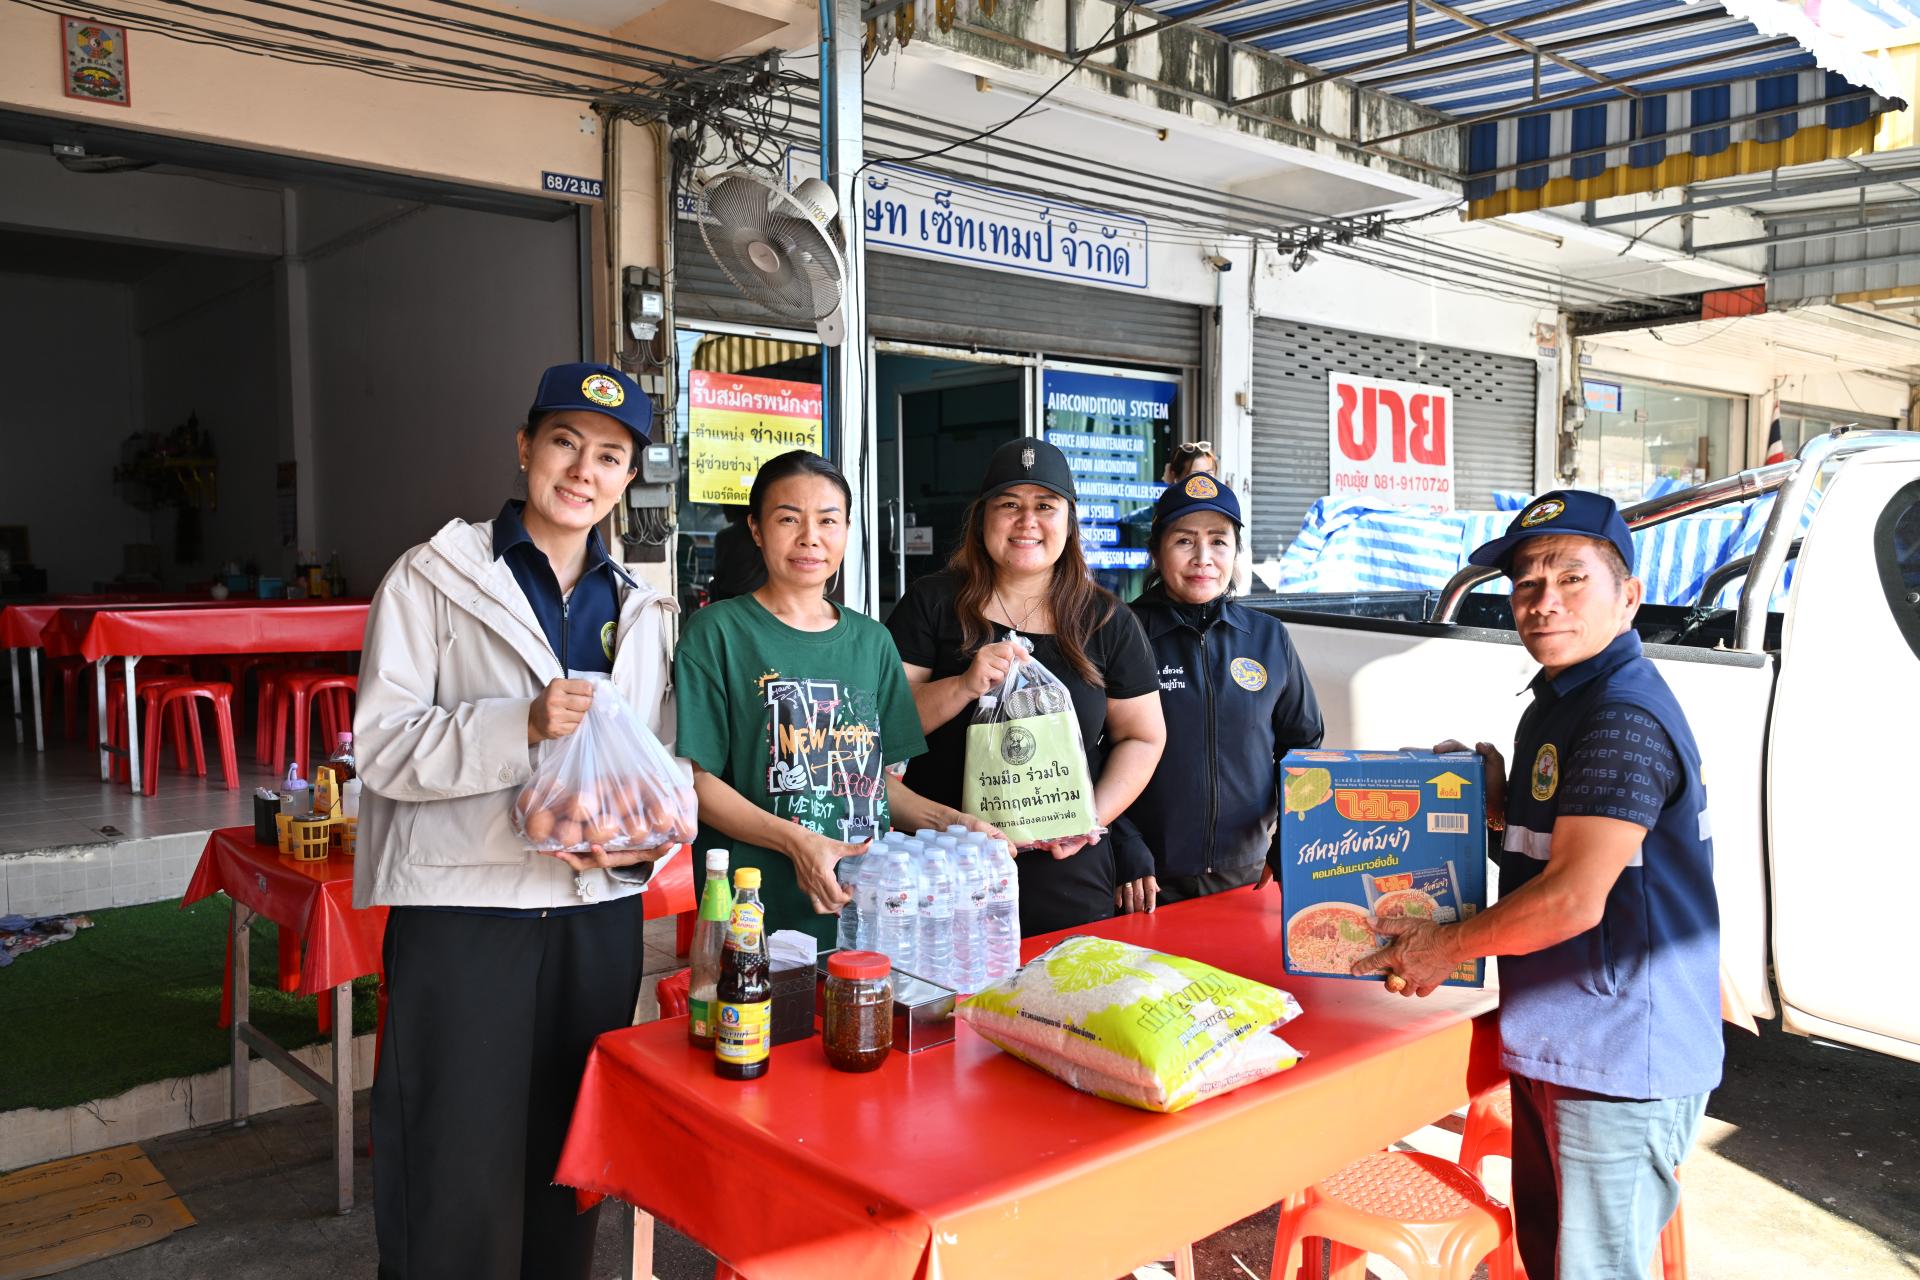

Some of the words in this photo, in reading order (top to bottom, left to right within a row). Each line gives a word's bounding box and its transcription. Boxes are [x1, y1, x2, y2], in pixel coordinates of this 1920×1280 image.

[546, 174, 579, 194] 68/2
[580, 180, 601, 196] ม.6
[919, 190, 1053, 263] เซ็ทเทมป์
[1060, 220, 1131, 277] จำกัด
[1047, 391, 1127, 416] AIRCONDITION
[1129, 399, 1169, 420] SYSTEM
[750, 421, 817, 447] ช่างแอร์
[1336, 382, 1447, 467] ขาย
[1048, 432, 1076, 448] SERVICE
[1075, 434, 1090, 449] AND
[1089, 434, 1134, 451] MAINTENANCE
[1133, 438, 1145, 452] AIR
[1094, 458, 1138, 475] AIRCONDITION
[702, 486, 751, 501] เบอร์ติดต่
[1080, 481, 1125, 498] MAINTENANCE
[1124, 483, 1149, 499] CHILLER
[1090, 505, 1115, 519] SYSTEM
[1092, 528, 1117, 542] SYSTEM
[779, 722, 827, 759] NEW
[832, 724, 875, 752] YORK
[1622, 751, 1653, 767] and
[979, 768, 1021, 788] ร่วมมือ
[1026, 761, 1070, 783] ร่วมใจ
[1623, 770, 1652, 786] you
[980, 786, 1081, 813] ฝ่าวิกฤตน้ำท่วม
[1296, 825, 1411, 865] รสหมูสับต้มยำ
[1311, 853, 1400, 881] หอมกลิ่นมะนาวยิ่งขึ้น
